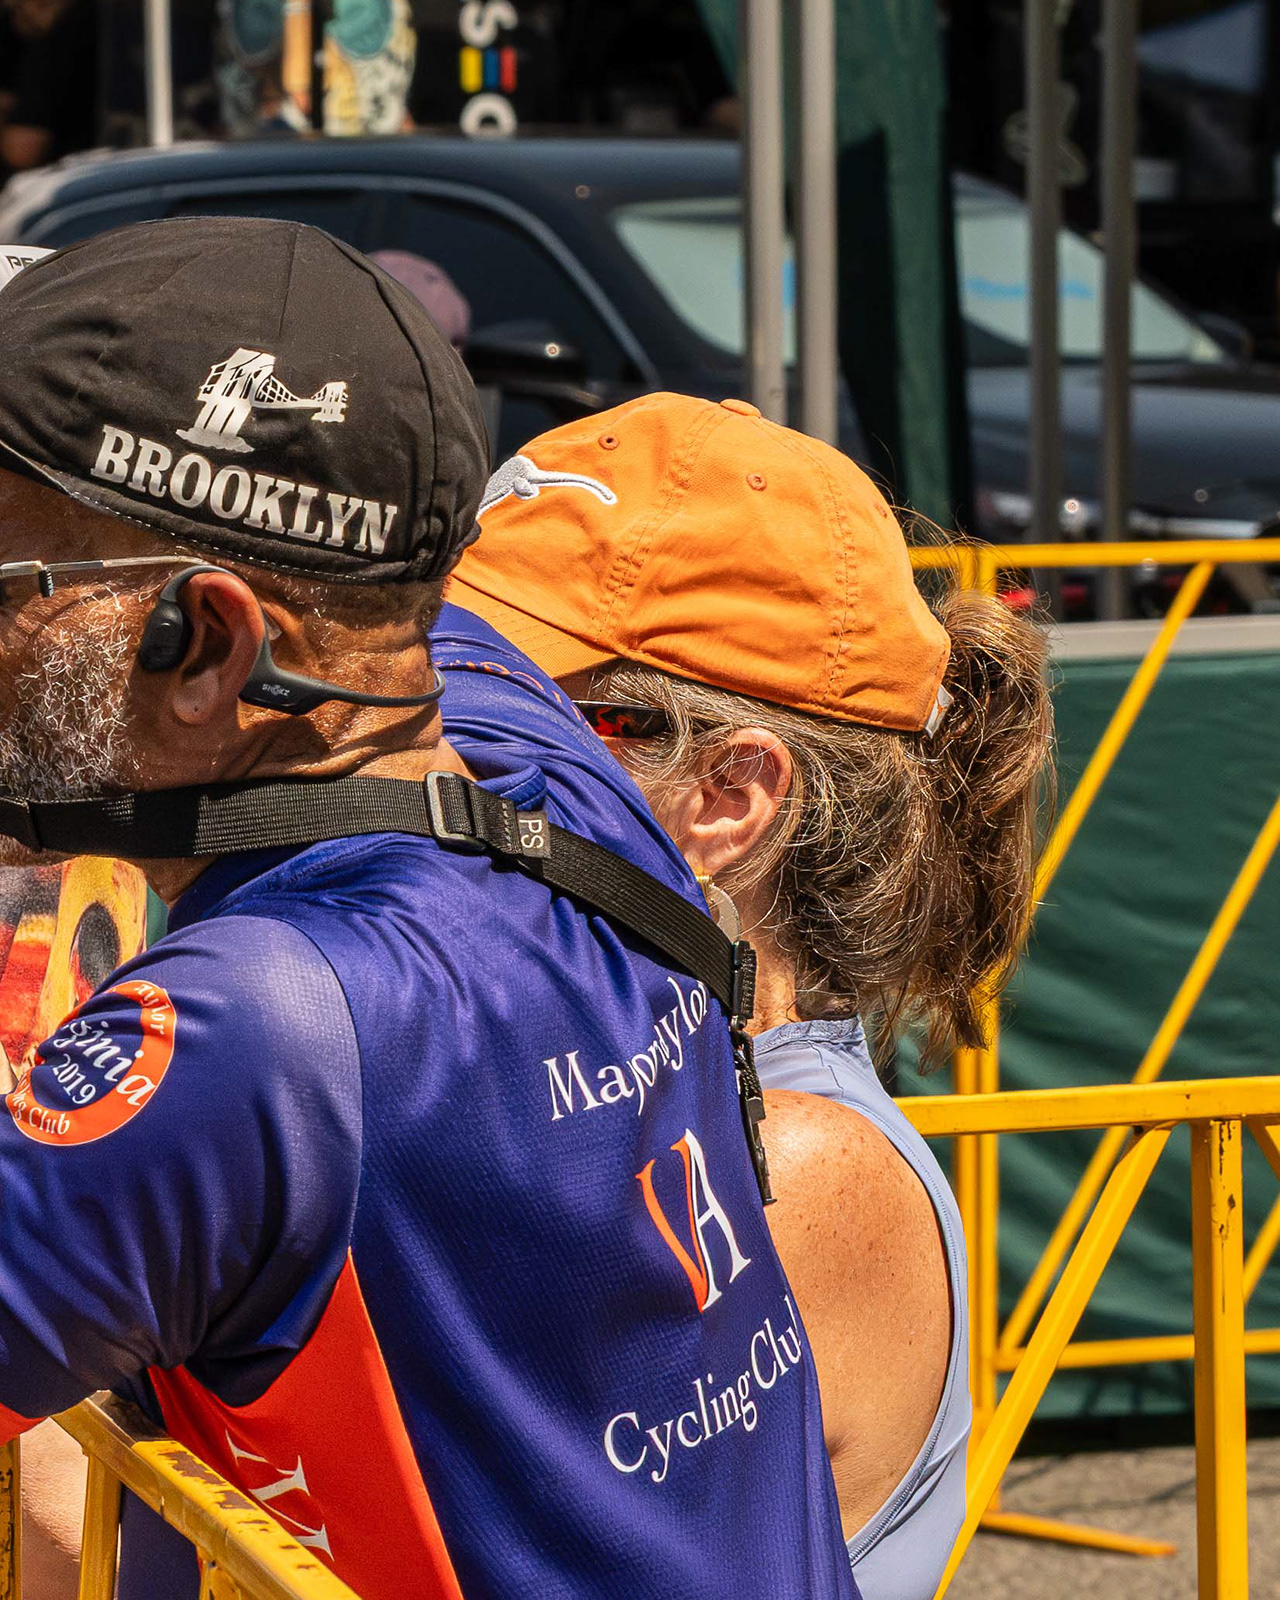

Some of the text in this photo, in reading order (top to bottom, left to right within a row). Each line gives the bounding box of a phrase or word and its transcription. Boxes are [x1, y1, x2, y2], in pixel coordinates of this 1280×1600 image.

[90, 423, 398, 556] BROOKLYN
[519, 817, 545, 850] PS
[51, 1052, 97, 1105] 2019
[28, 1106, 72, 1135] Club
[603, 1372, 758, 1483] Cycling
